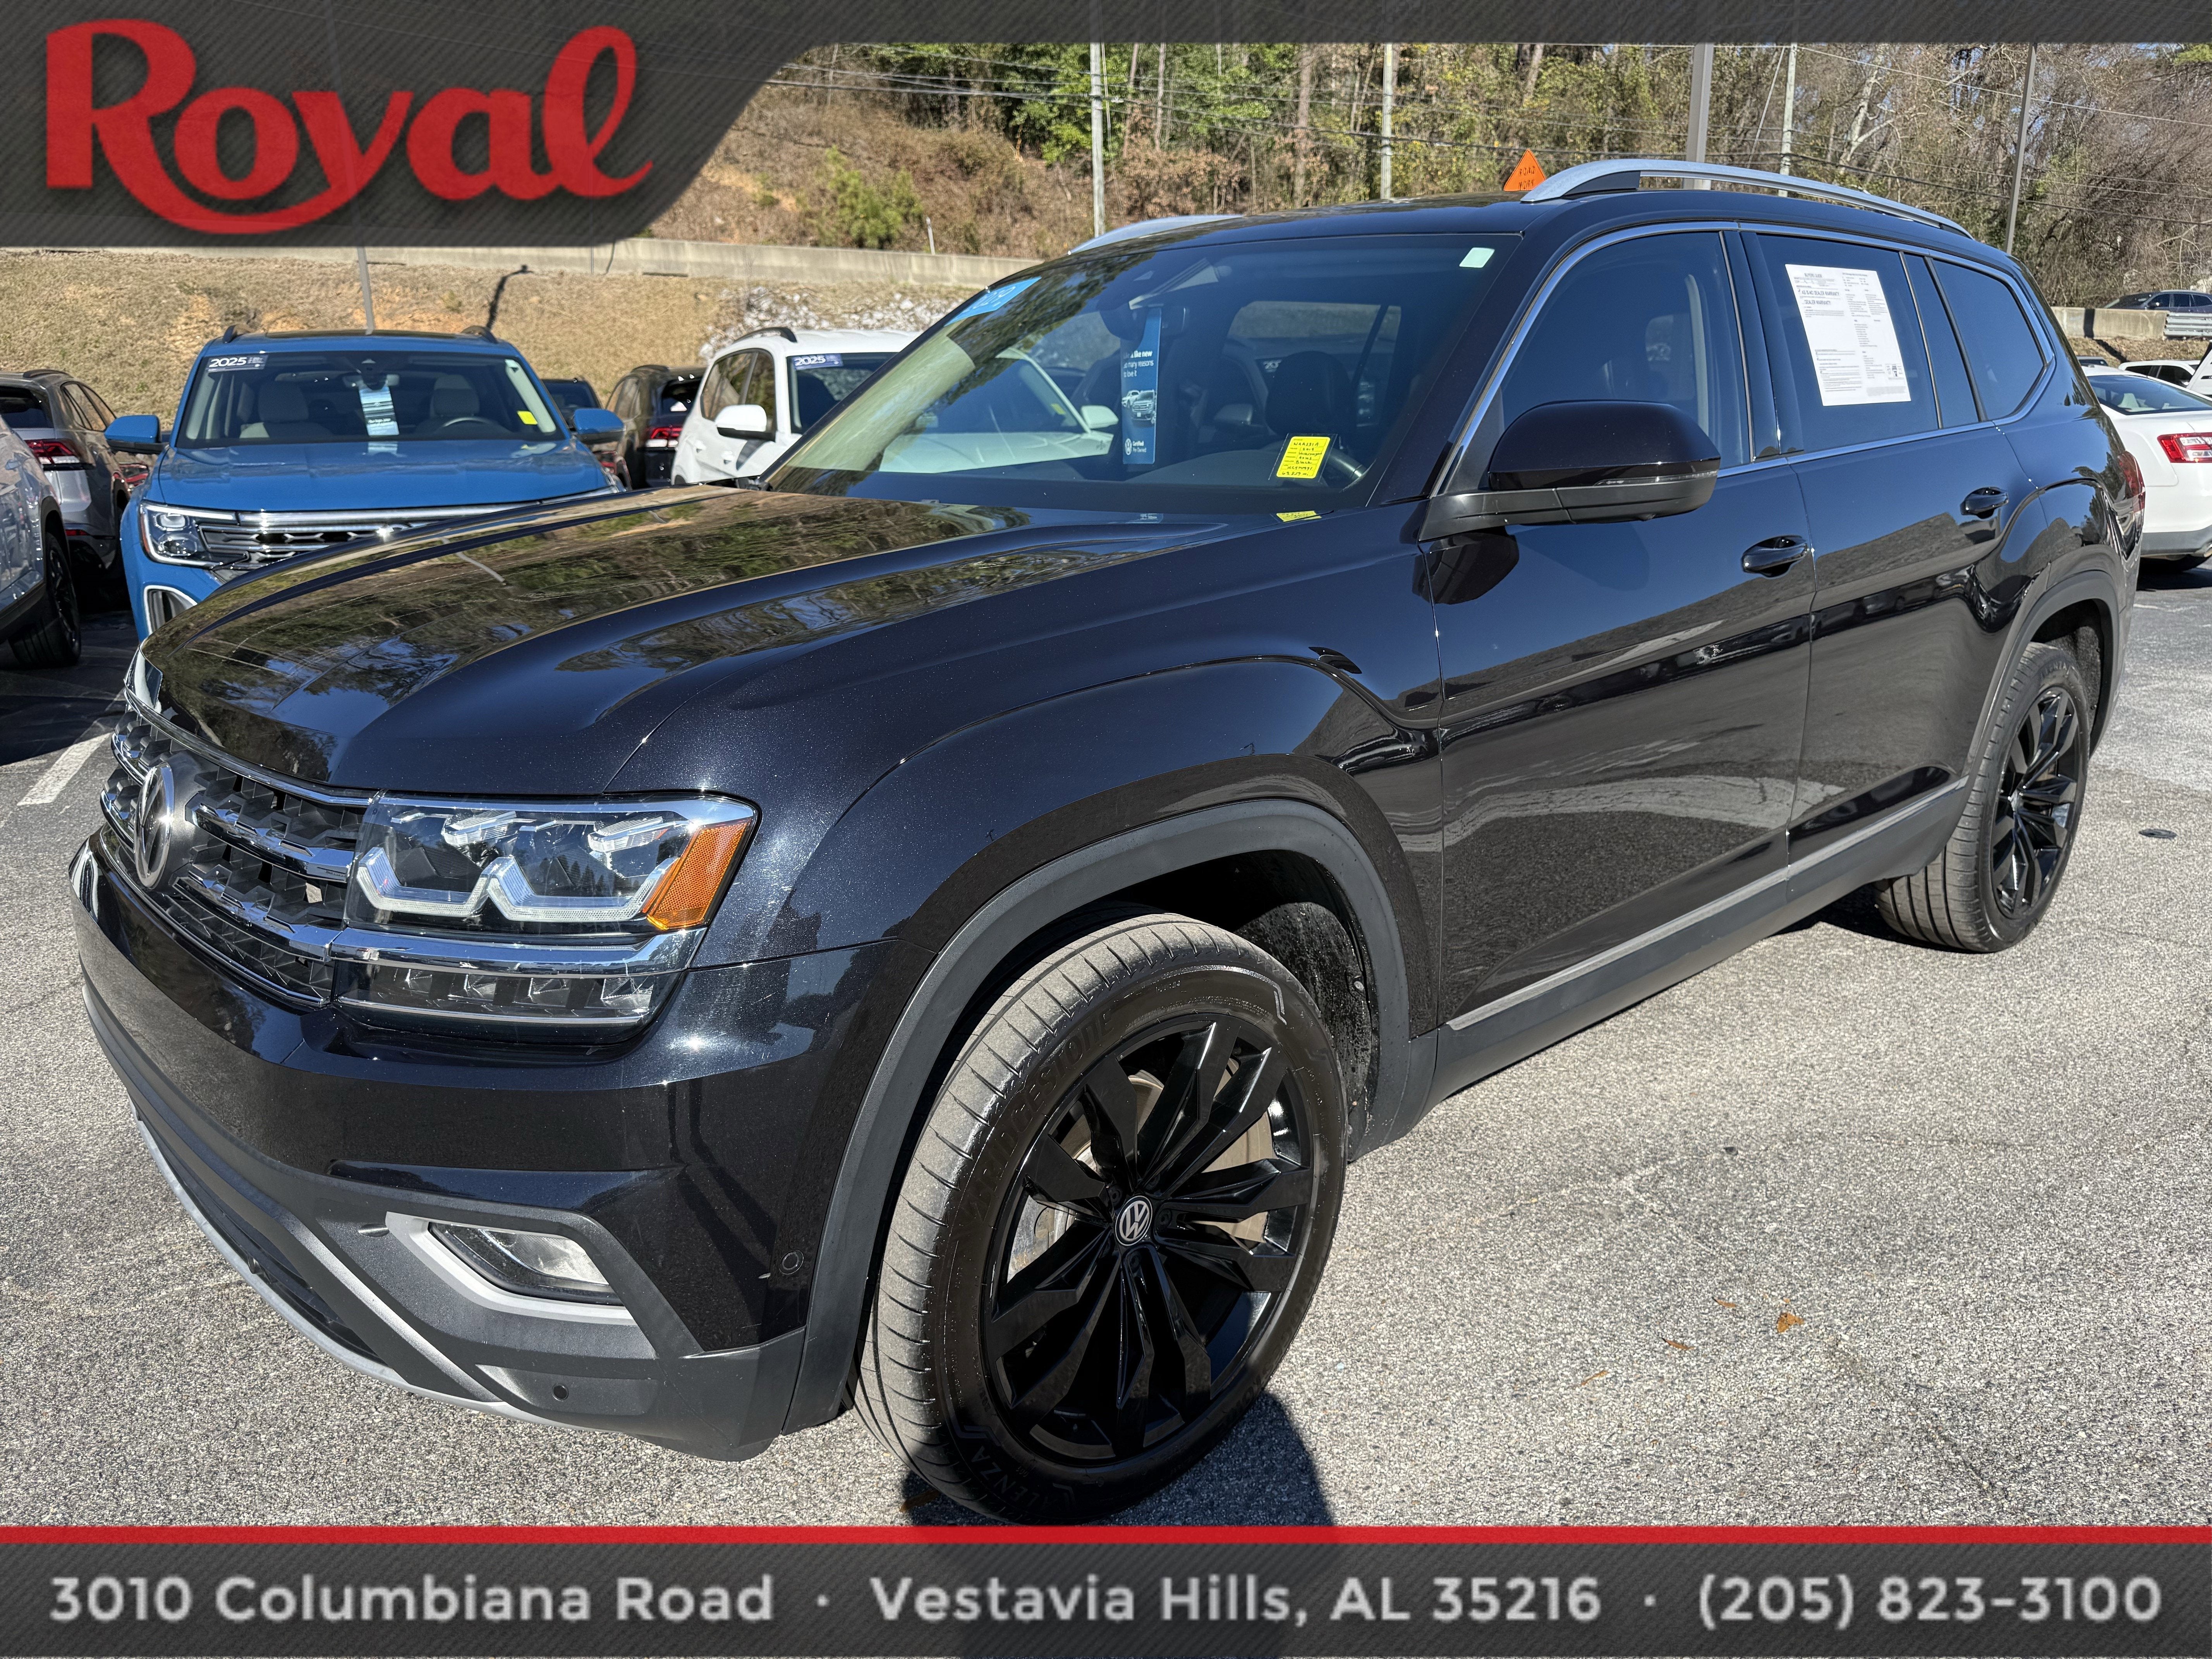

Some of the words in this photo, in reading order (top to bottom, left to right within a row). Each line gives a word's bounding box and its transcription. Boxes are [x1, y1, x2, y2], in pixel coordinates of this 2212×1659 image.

[1518, 166, 1535, 176] ROAD
[209, 357, 247, 368] 2025
[794, 355, 826, 366] 2025
